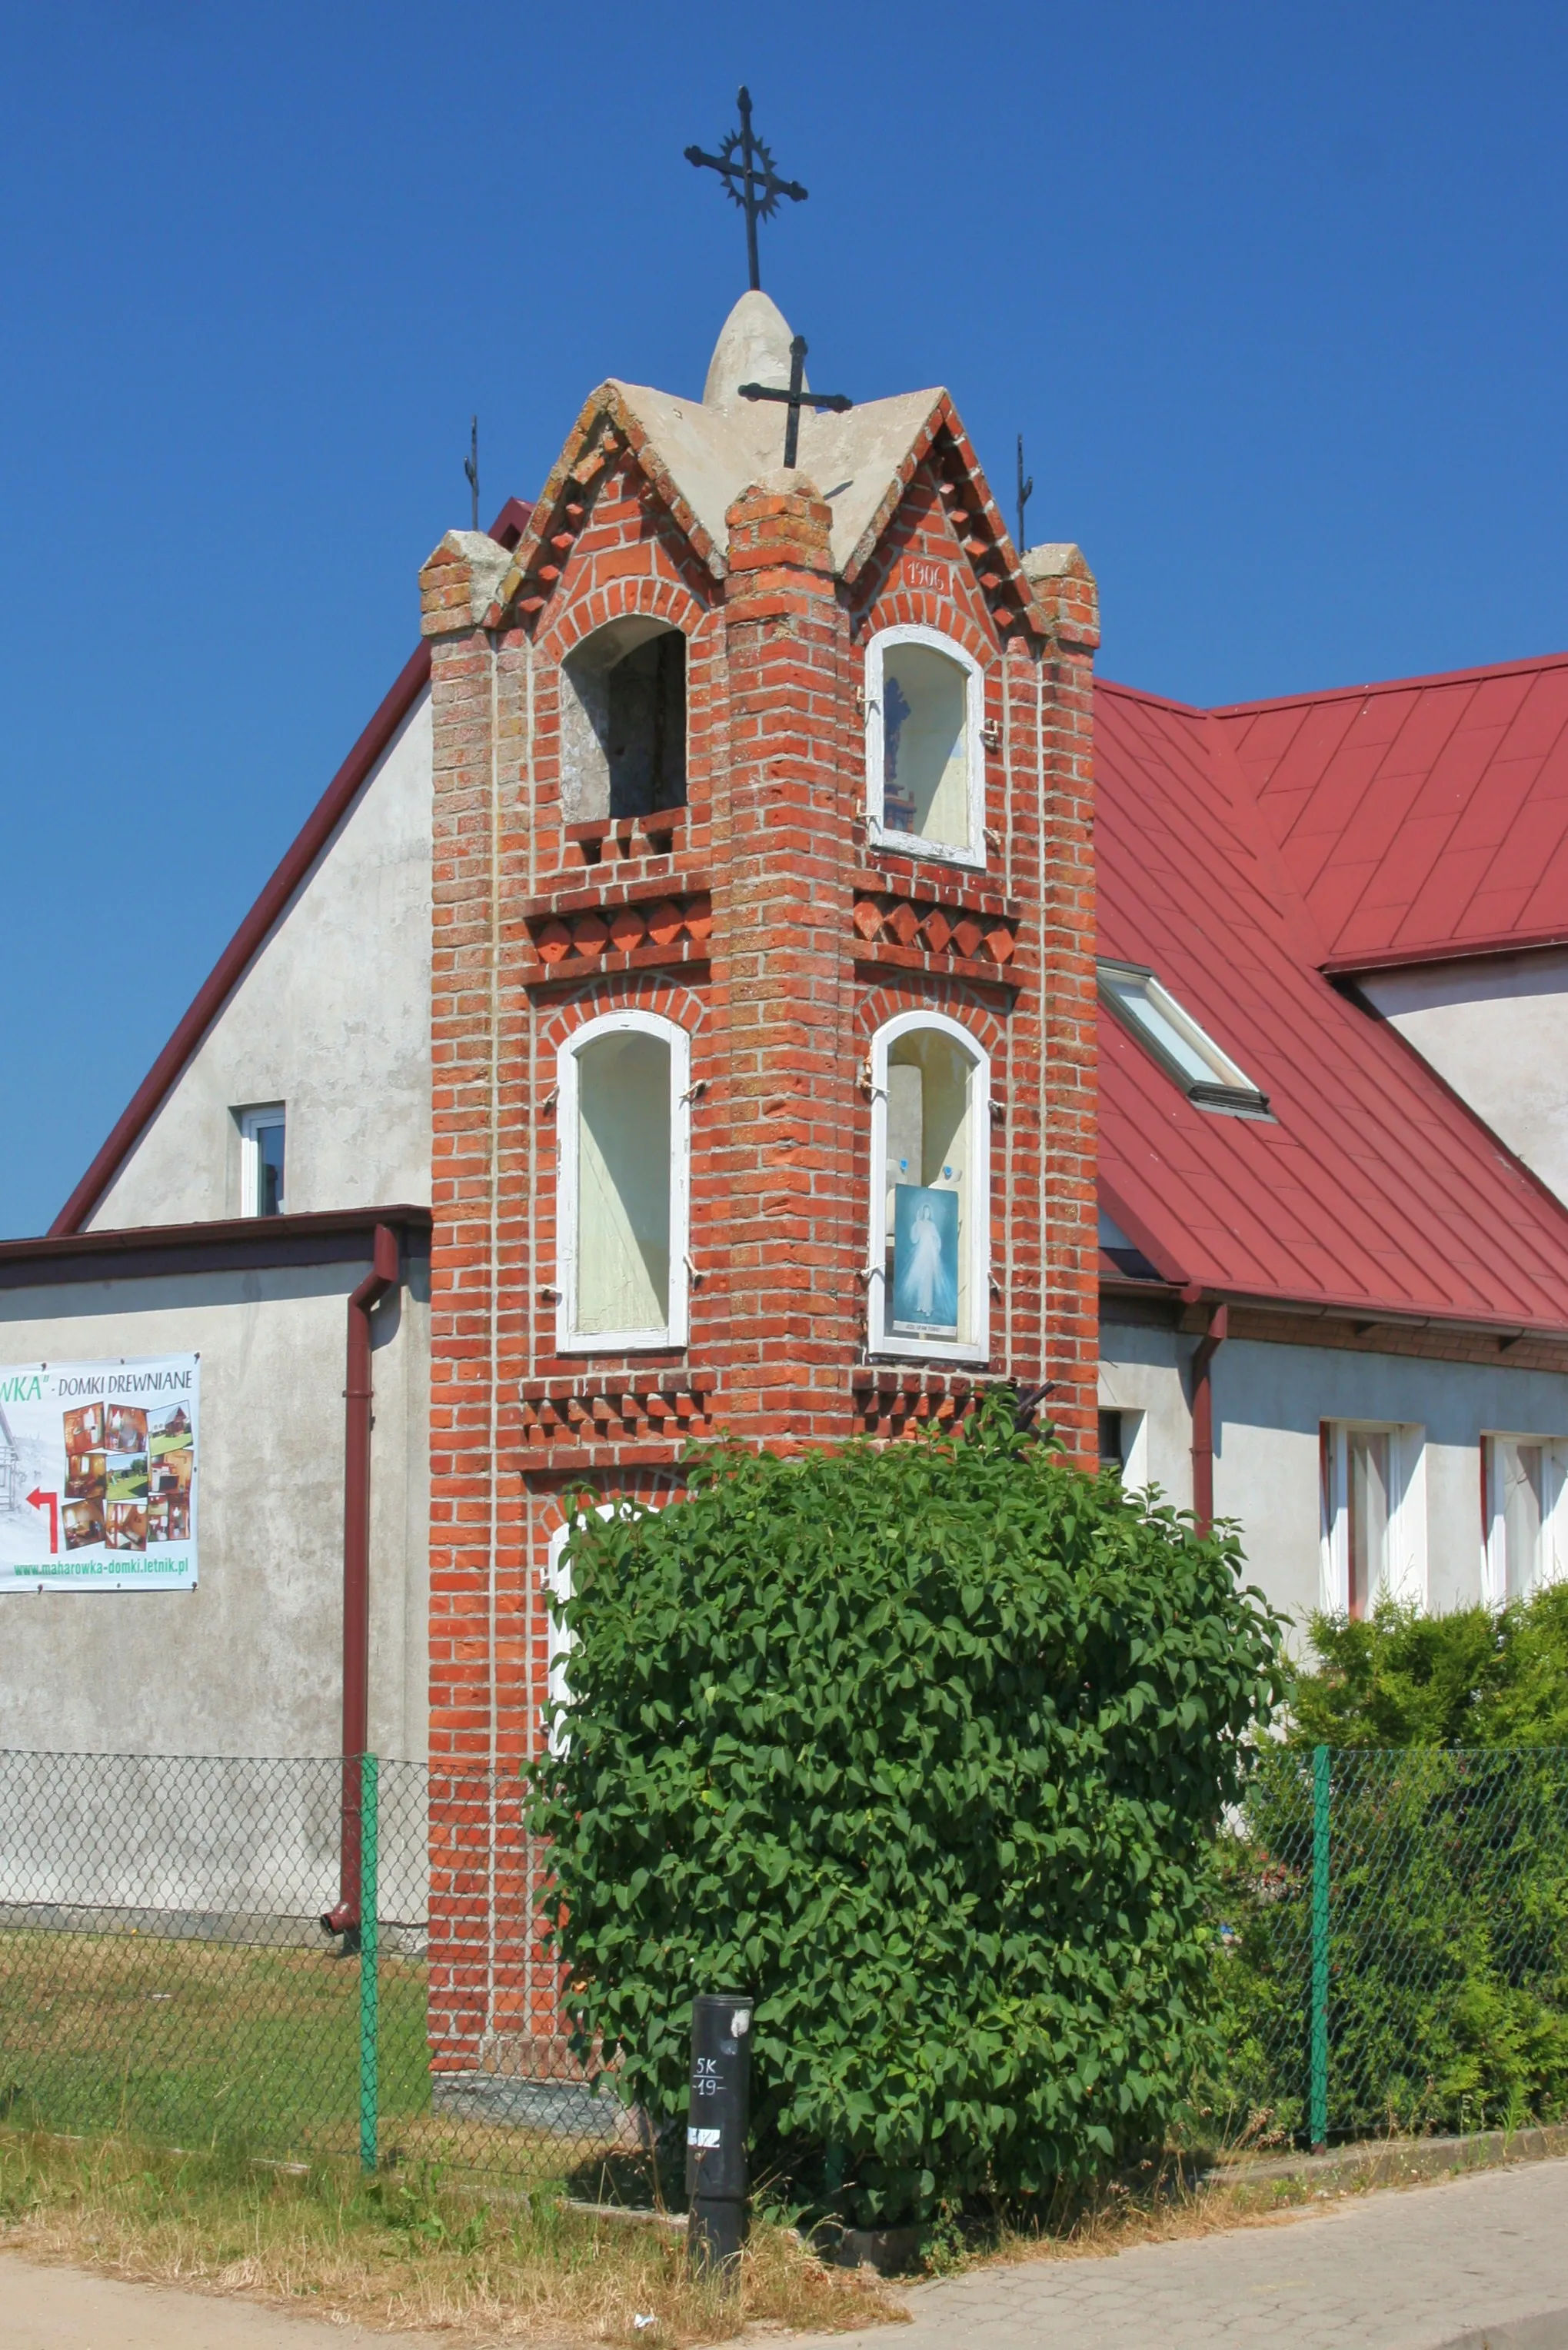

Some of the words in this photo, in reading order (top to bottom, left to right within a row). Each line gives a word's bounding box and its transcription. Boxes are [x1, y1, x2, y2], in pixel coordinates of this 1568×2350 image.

[907, 561, 944, 590] 1906
[59, 1376, 105, 1396] DOMKI
[108, 1370, 192, 1393] DREWNIANE
[14, 1557, 188, 1576] www.maharowka-domki.letnik.pl
